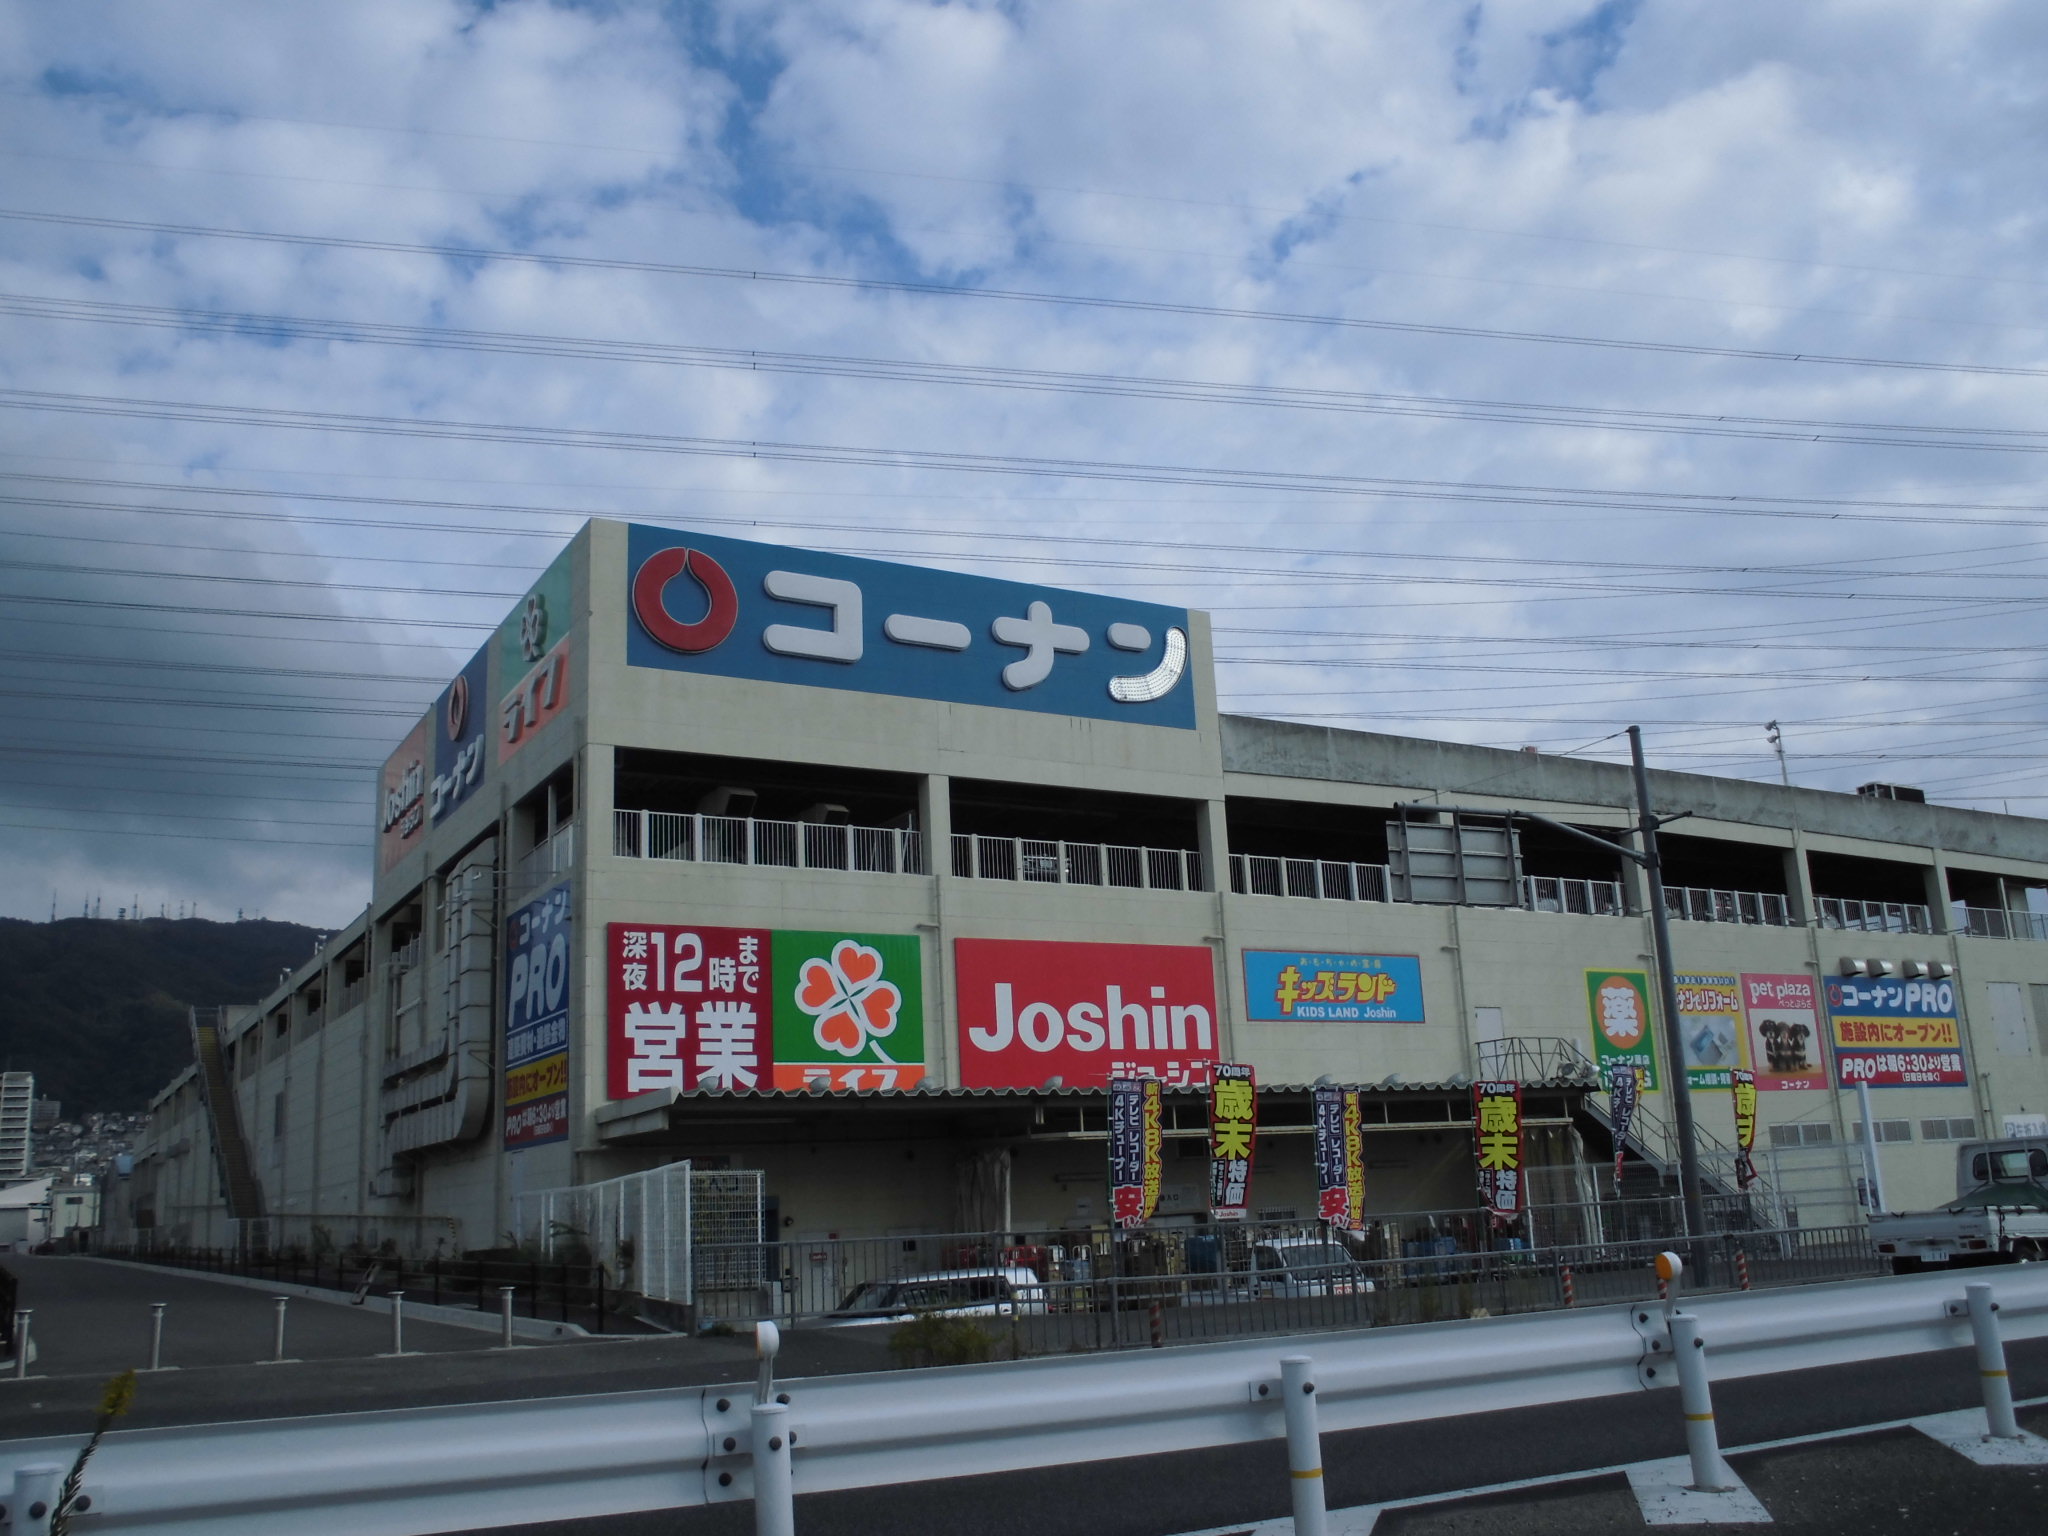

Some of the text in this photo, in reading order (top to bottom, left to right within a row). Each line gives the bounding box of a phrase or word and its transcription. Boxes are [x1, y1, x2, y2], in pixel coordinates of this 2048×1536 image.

[763, 570, 1188, 703] コーナン
[503, 654, 561, 744] ライフ
[380, 761, 424, 833] Joshin
[430, 734, 485, 820] コーナン
[519, 890, 567, 946] コーナン
[508, 932, 566, 1028] PRO
[1277, 965, 1396, 1013] キッズランド
[1675, 988, 1739, 1011] ナンでリフォーム
[1750, 981, 1811, 1004] pet plaza
[968, 982, 1212, 1053] Joshin
[1297, 1006, 1396, 1018] KIDS LAND Joshin
[1600, 987, 1638, 1037] 薬
[624, 1001, 758, 1092] 営業
[1214, 1065, 1251, 1077] 70周年
[1478, 1083, 1516, 1093] 70周年
[1781, 1080, 1810, 1090] コーナン
[1129, 1096, 1139, 1126] テレビ
[1213, 1080, 1254, 1160] 歳末
[1329, 1104, 1341, 1133] テレビ
[1478, 1096, 1519, 1170] 歳末
[1129, 1132, 1139, 1181] レコーダー
[1331, 1138, 1343, 1182] レコーダー
[1225, 1159, 1248, 1206] 特価
[1495, 1169, 1517, 1210] 特価
